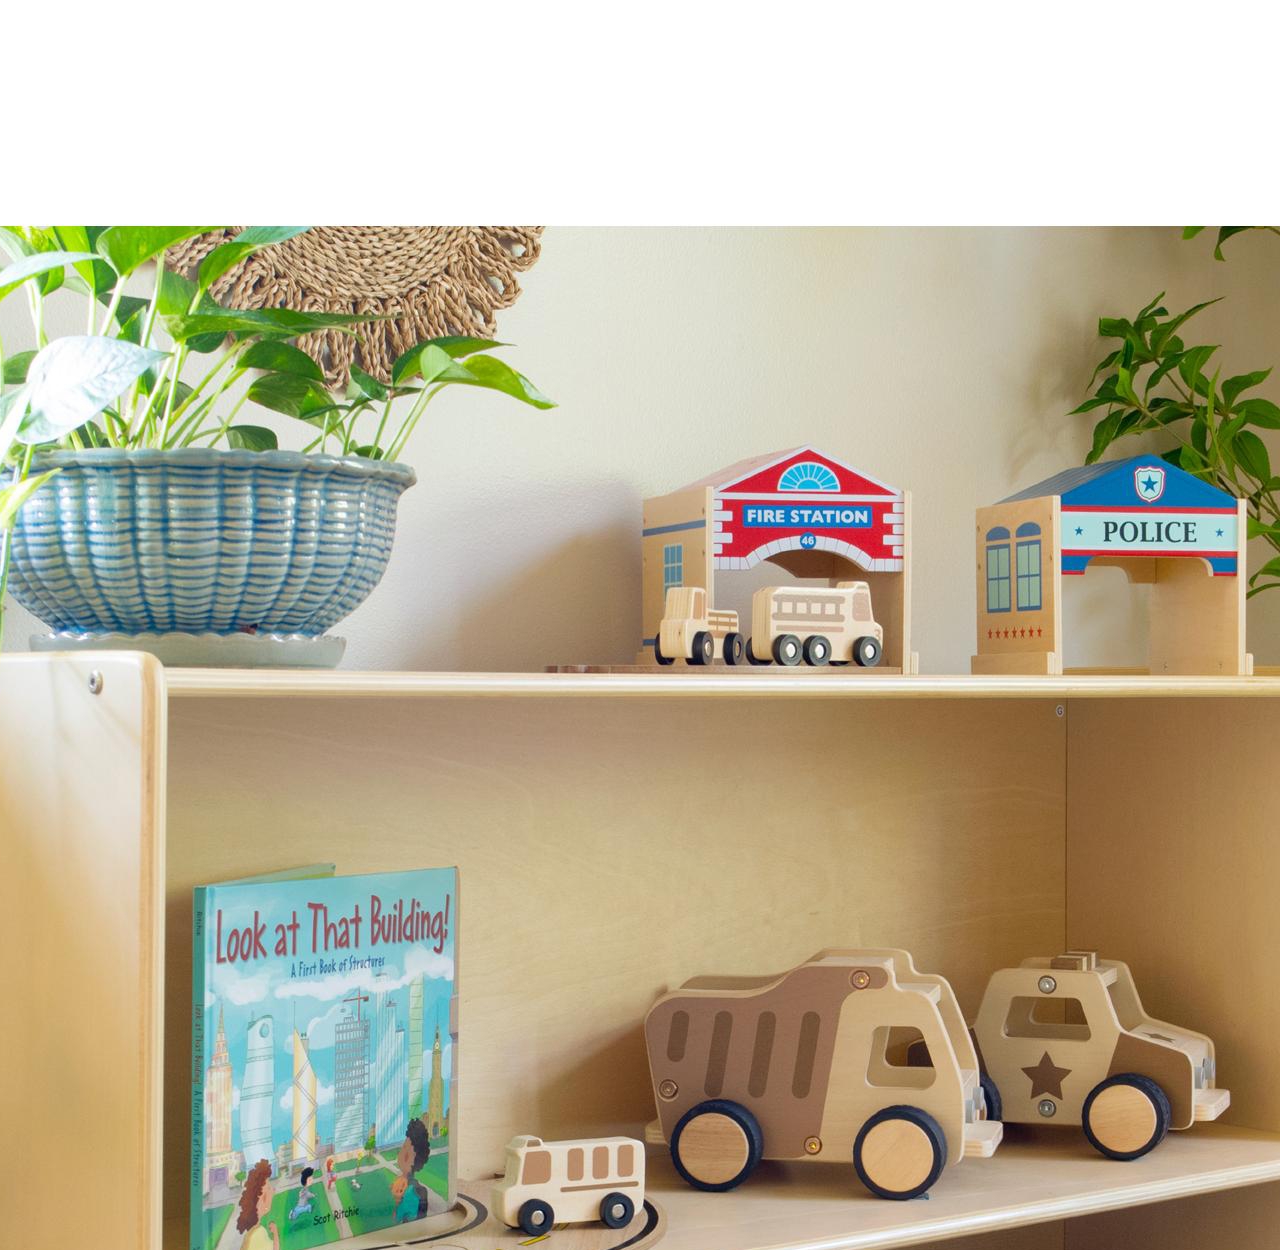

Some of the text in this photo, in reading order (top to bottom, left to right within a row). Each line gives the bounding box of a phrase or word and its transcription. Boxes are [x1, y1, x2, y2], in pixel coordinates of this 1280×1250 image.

[747, 509, 869, 525] FIRE STATION
[801, 535, 815, 546] 46
[1103, 521, 1198, 543] POLICE
[216, 894, 450, 964] Look at That Building!
[291, 954, 385, 978] A First Book of Structures
[313, 1206, 360, 1226] Scot Ritchie
